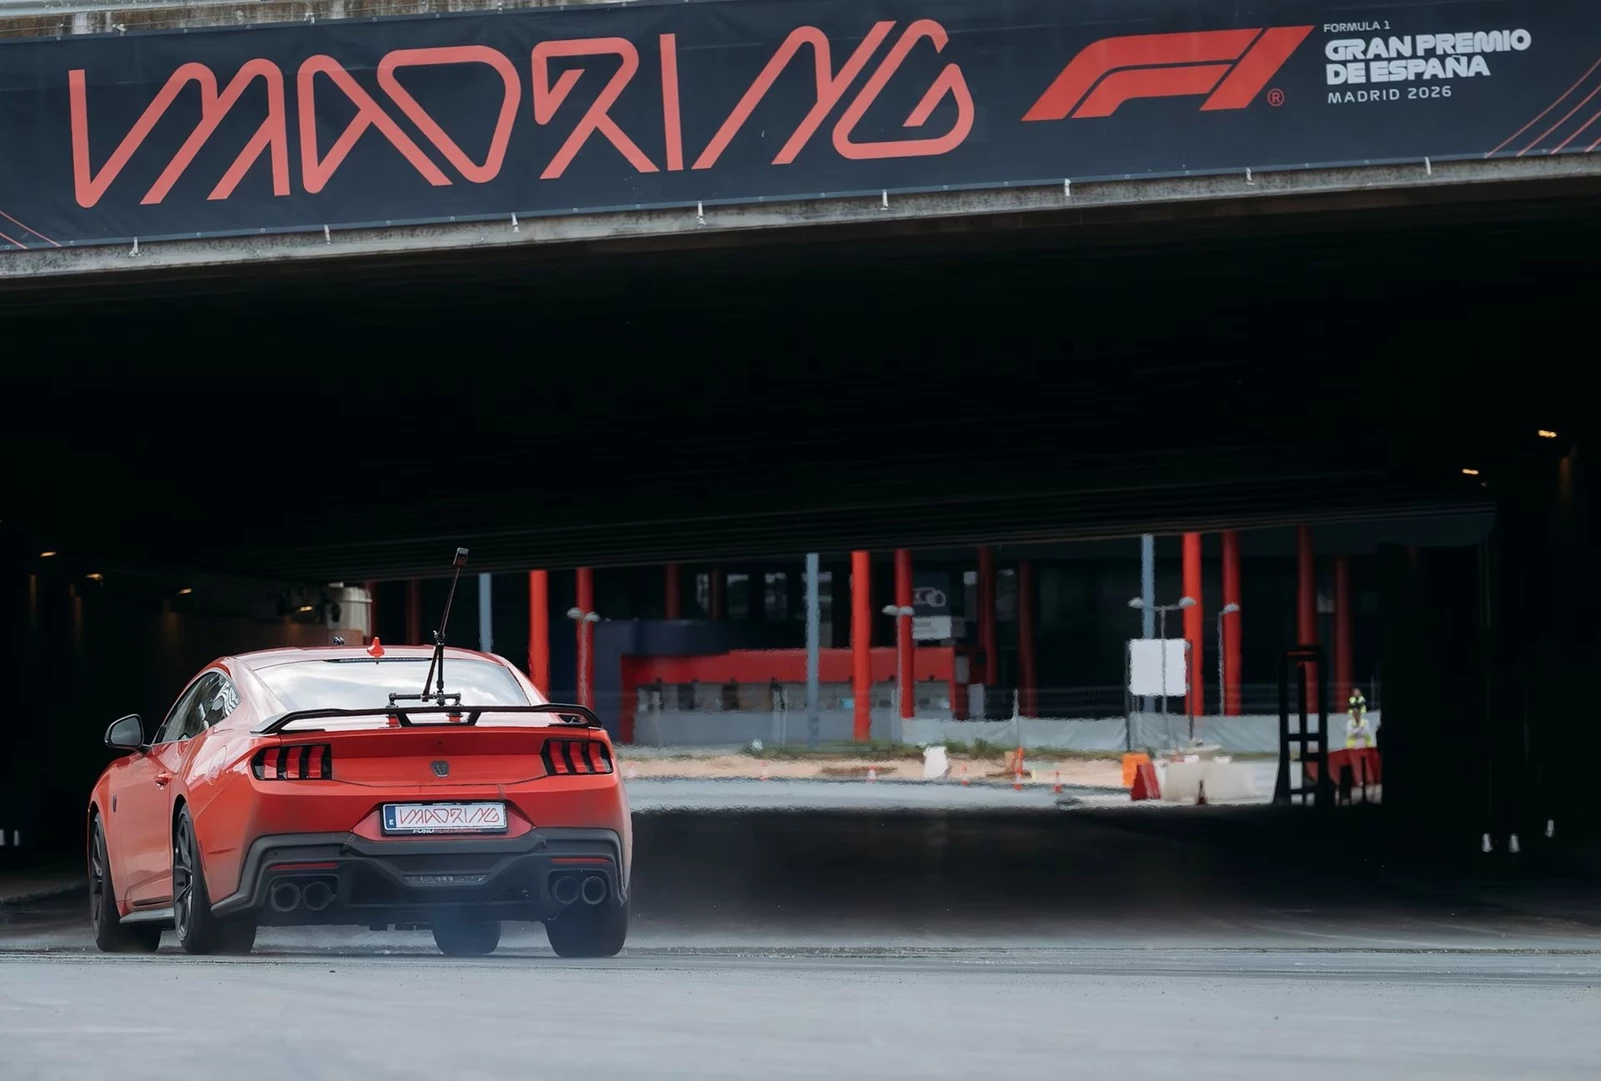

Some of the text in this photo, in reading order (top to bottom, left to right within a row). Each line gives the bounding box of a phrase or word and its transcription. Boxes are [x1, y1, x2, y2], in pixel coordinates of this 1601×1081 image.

[1324, 21, 1391, 32] FORMULA 1
[1325, 29, 1532, 62] GRAN PREMIO
[1326, 55, 1491, 85] DE ESPAÑA
[1327, 86, 1452, 104] MADRID 2026
